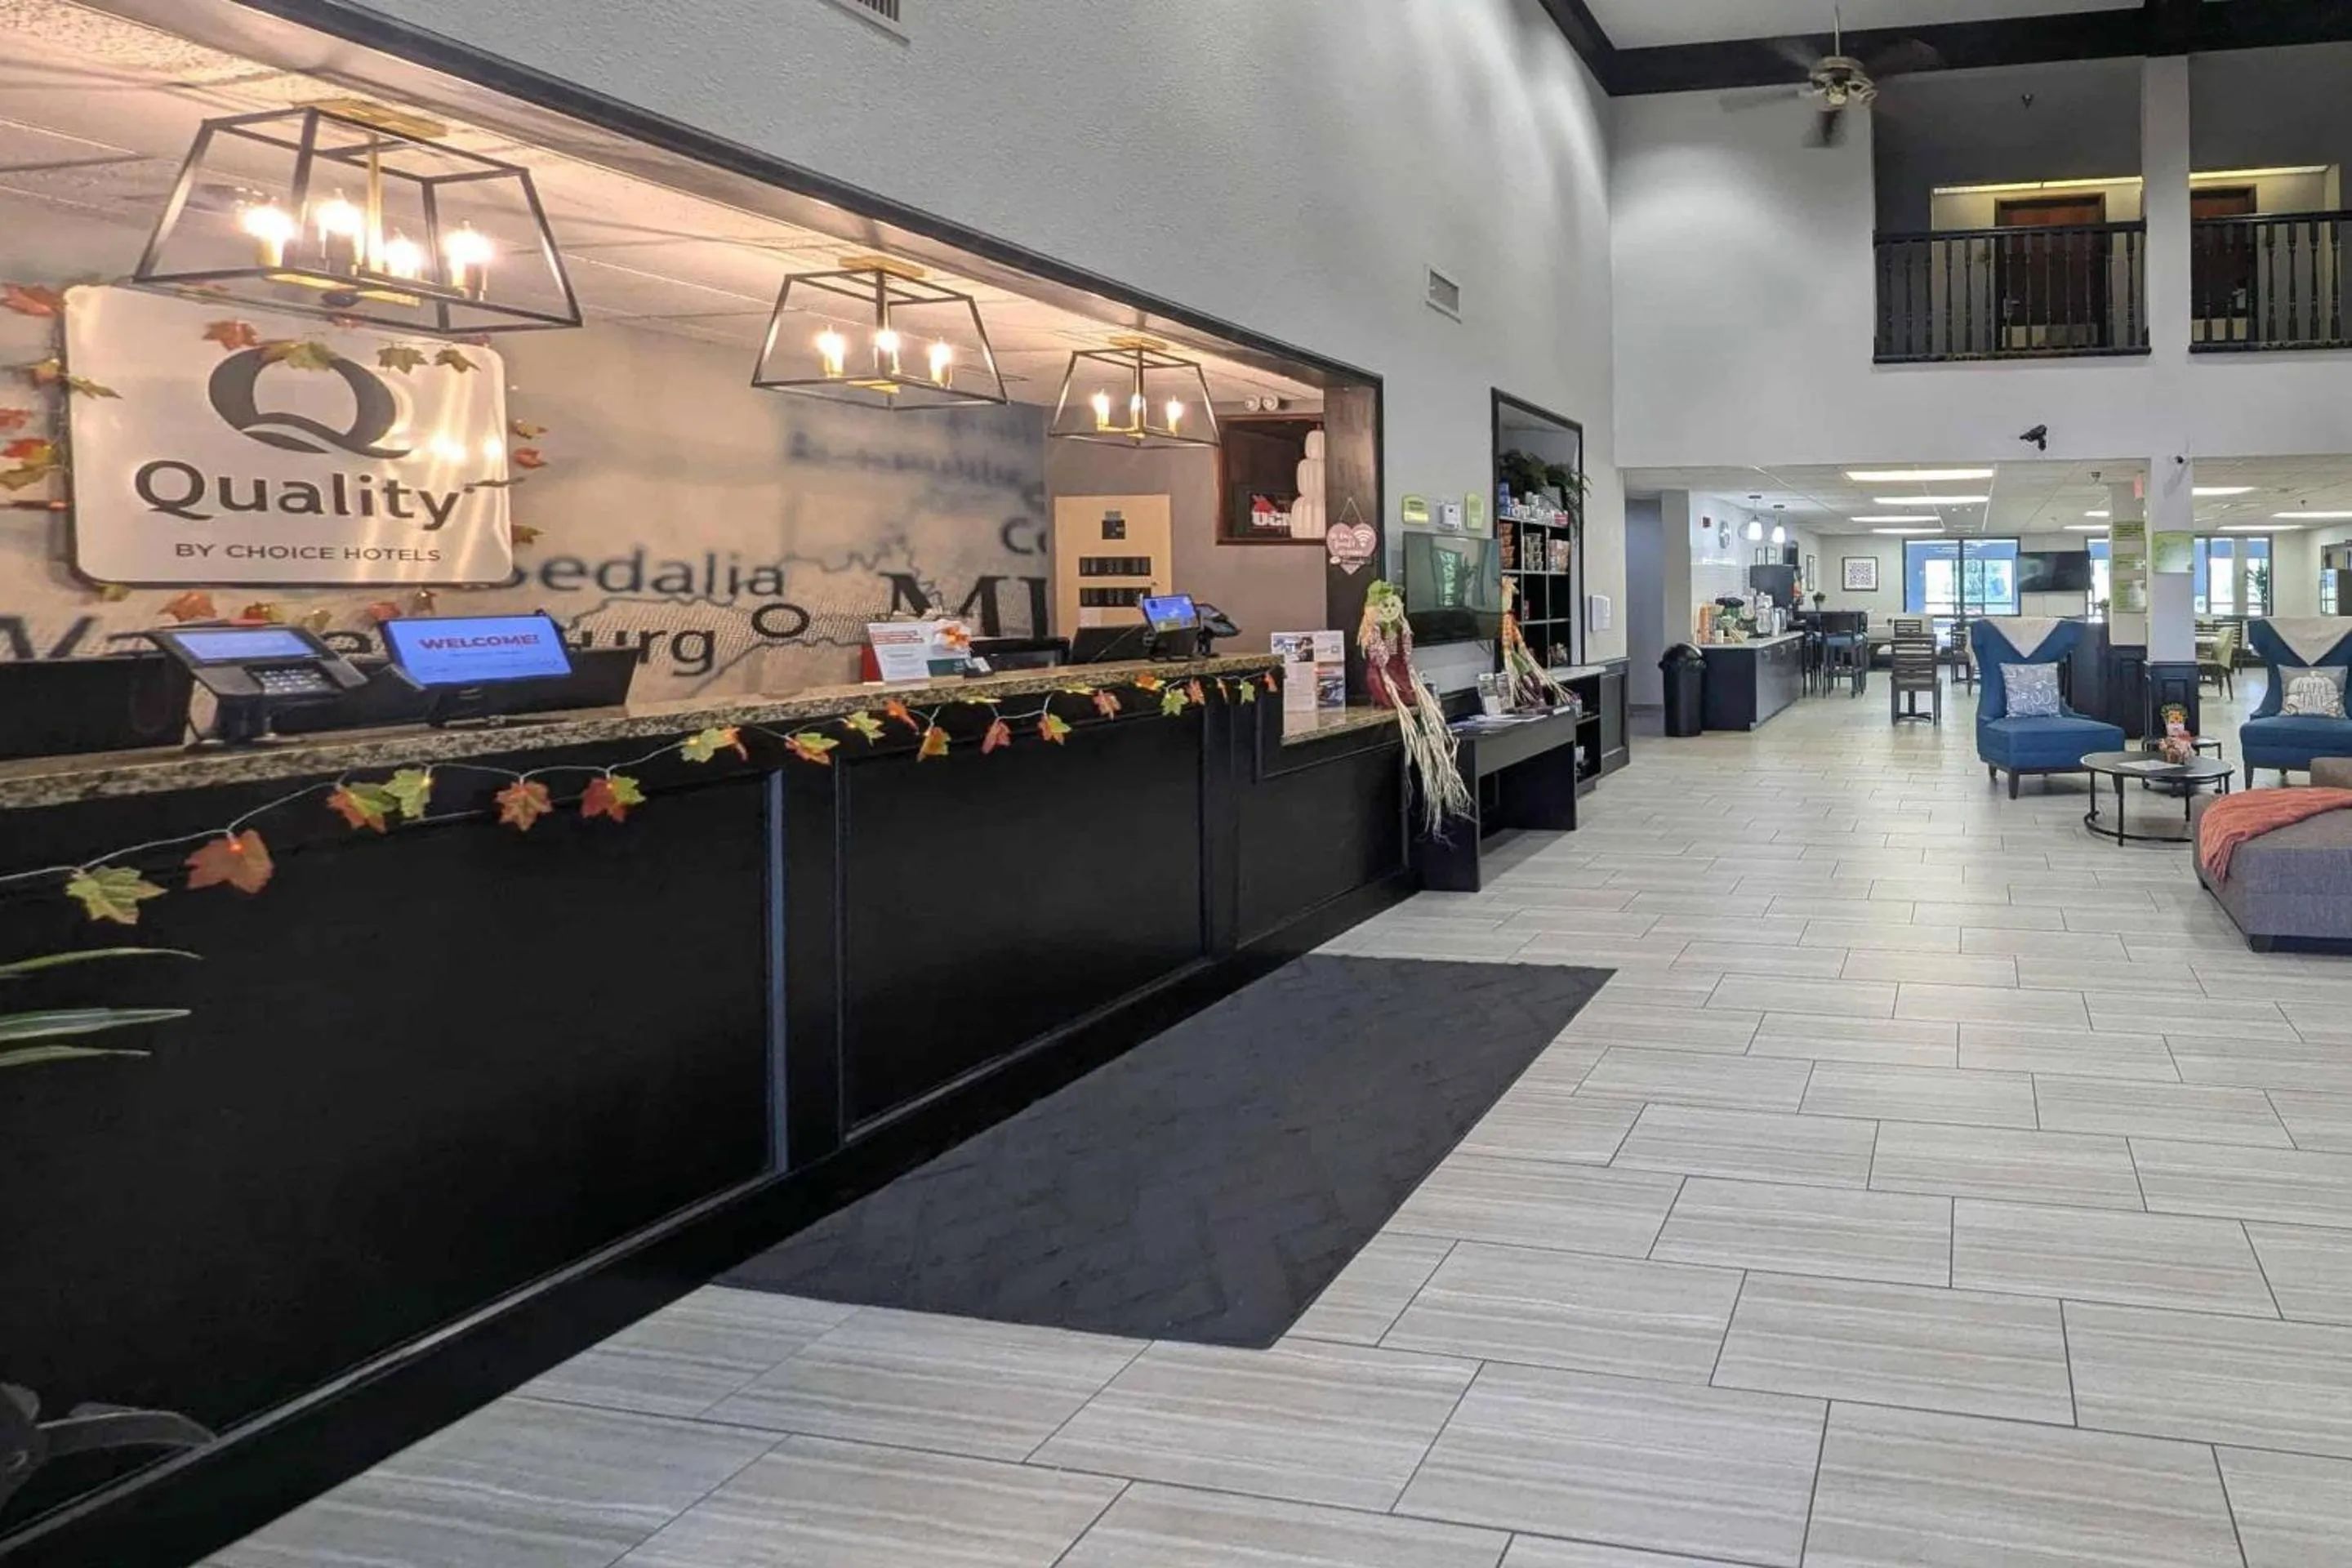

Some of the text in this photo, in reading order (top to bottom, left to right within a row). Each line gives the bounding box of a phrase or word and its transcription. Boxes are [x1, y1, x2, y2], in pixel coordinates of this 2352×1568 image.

[135, 460, 462, 530] Quality
[175, 542, 441, 562] BY CHOICE HOTELS
[419, 634, 541, 651] WELCOME!
